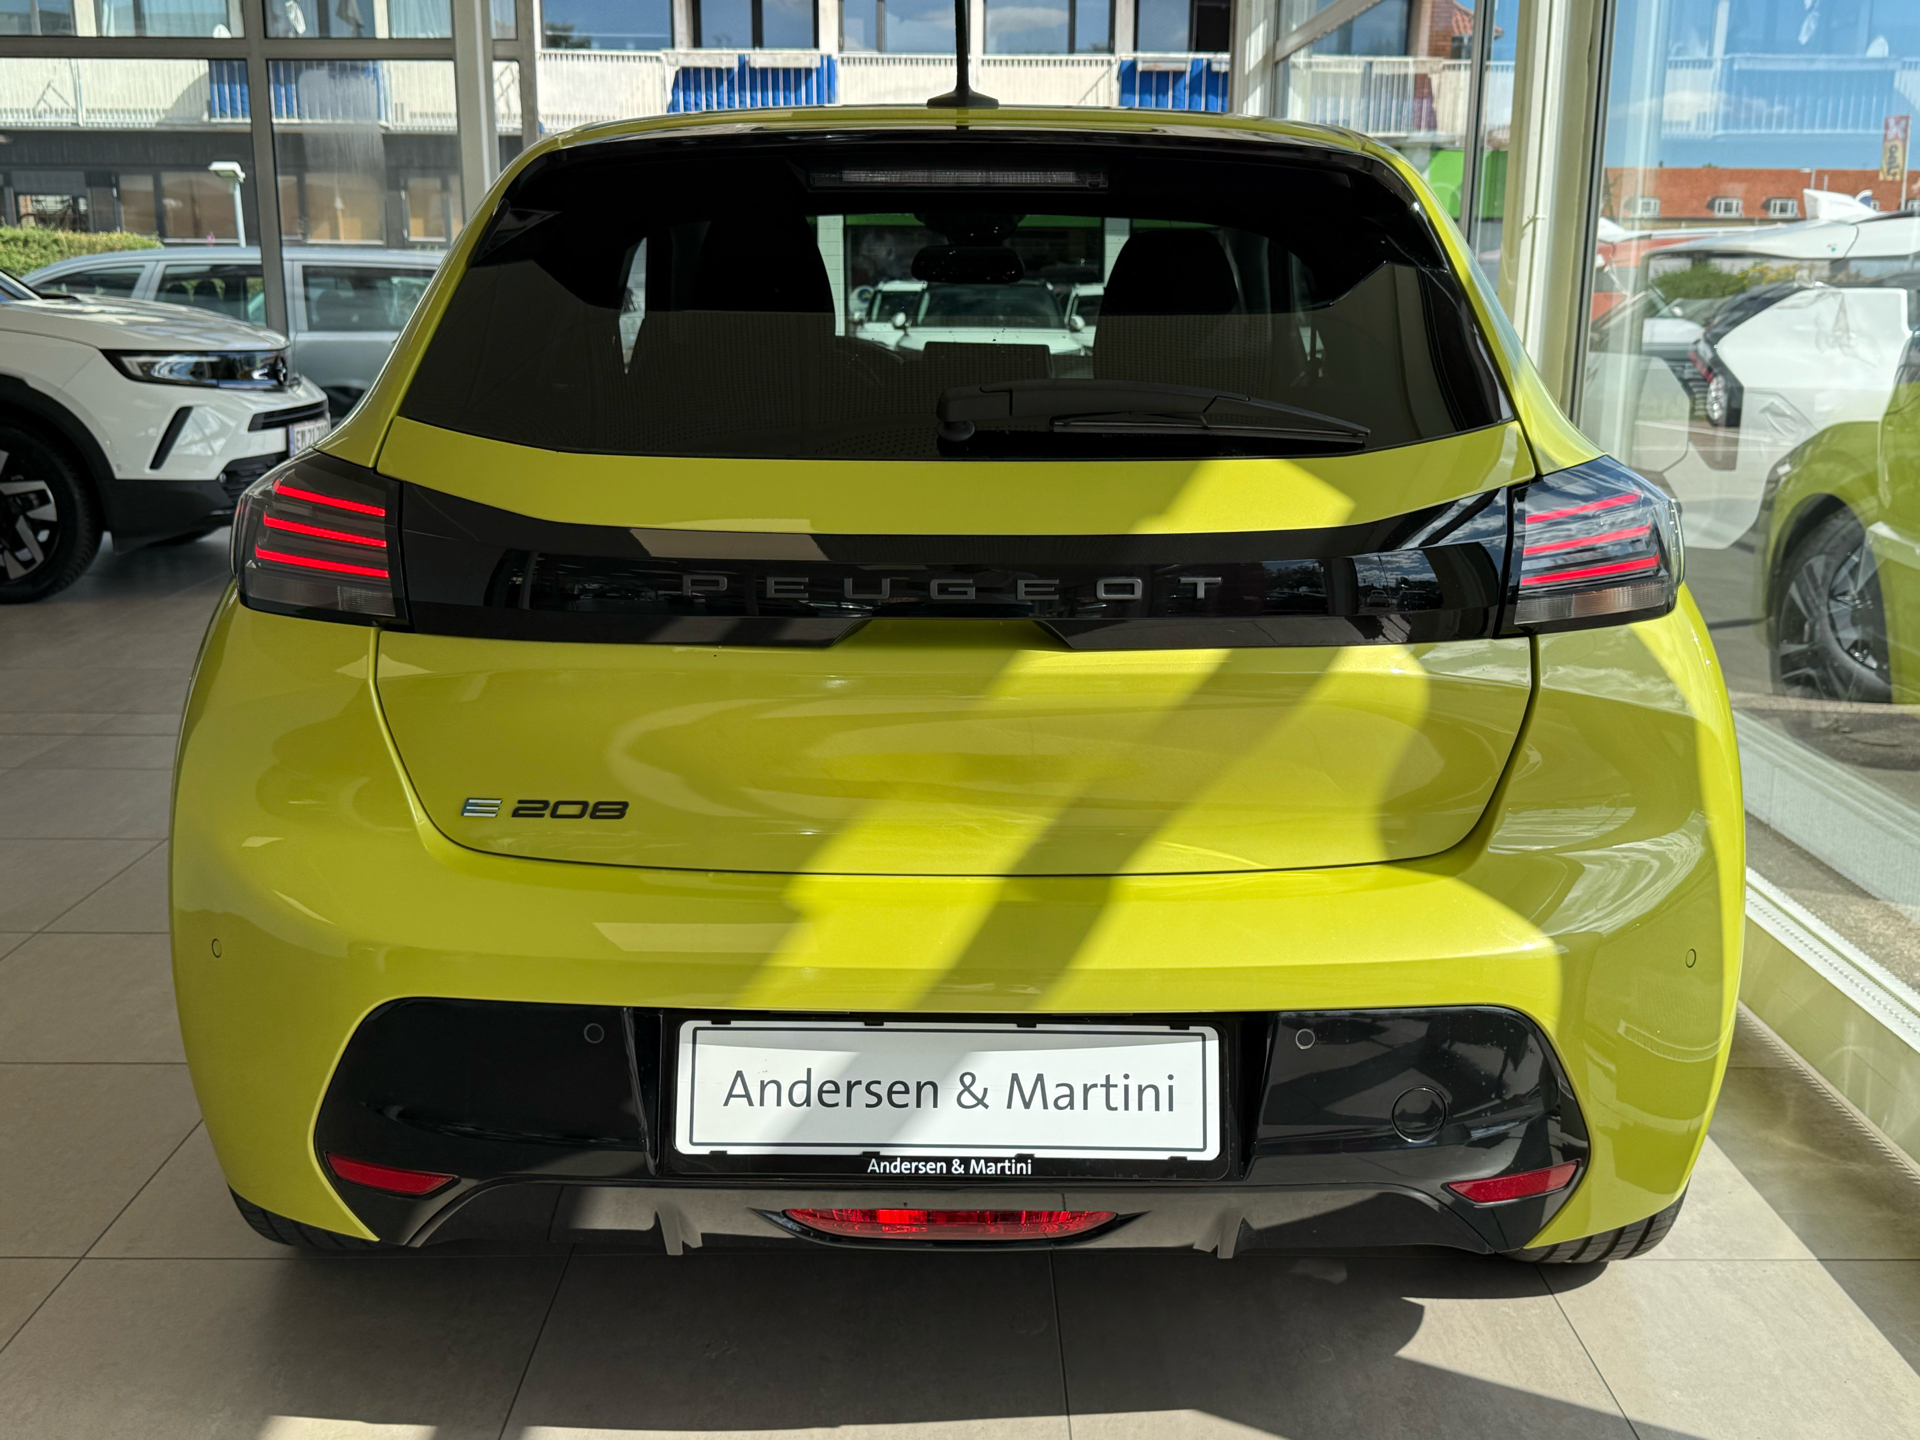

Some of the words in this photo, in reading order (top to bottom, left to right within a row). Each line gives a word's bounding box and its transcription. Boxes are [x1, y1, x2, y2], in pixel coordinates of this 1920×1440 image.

[682, 575, 1222, 600] PEUGEOT
[511, 799, 630, 820] 208
[722, 1067, 939, 1109] Andersen
[956, 1071, 990, 1110] &
[1006, 1072, 1175, 1112] Martini
[867, 1157, 947, 1174] Andersen
[951, 1158, 965, 1175] &
[969, 1159, 1032, 1175] Martini
